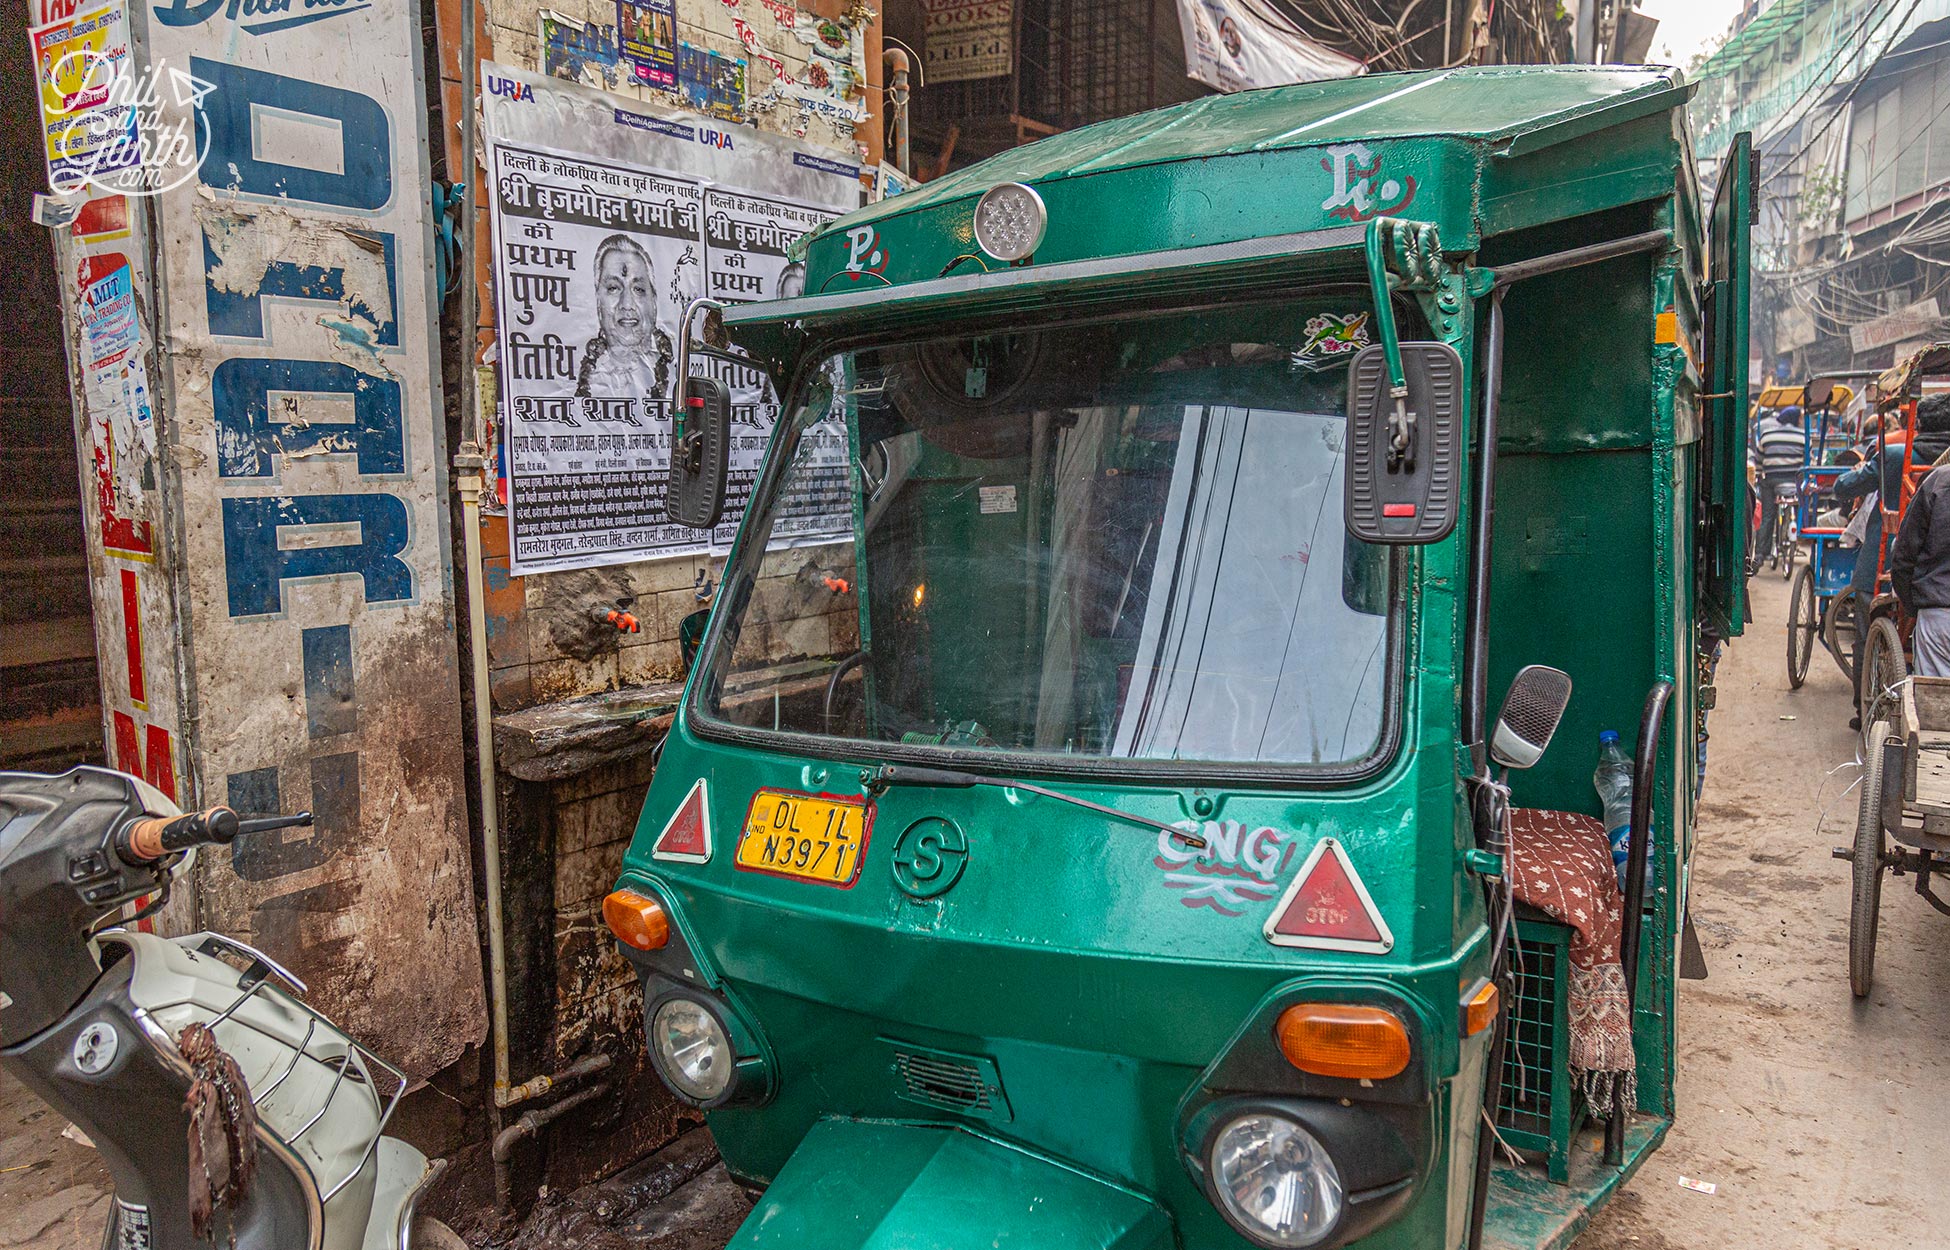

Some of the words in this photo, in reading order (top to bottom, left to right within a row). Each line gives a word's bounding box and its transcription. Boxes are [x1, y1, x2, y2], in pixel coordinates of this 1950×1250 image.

[488, 75, 535, 103] URJA
[621, 113, 694, 139] #DelhiAgainstPollution
[700, 128, 733, 150] URJA
[503, 152, 536, 171] दिल्ली
[540, 158, 550, 172] के
[553, 163, 598, 182] लोकप्रिय
[601, 170, 620, 186] नेता
[623, 177, 629, 188] व
[633, 178, 647, 194] पूर्व
[649, 178, 675, 195] निगम
[677, 183, 700, 200] पार्षद
[500, 174, 530, 208] श्री
[535, 185, 627, 226] बृजमोहन
[631, 198, 674, 232] शर्मा
[679, 204, 700, 233] जी
[710, 193, 735, 210] दिल्ली
[737, 199, 745, 211] के
[747, 202, 780, 218] लोकप्रिय
[782, 207, 797, 220] नेता
[807, 211, 818, 227] पूर्व
[524, 221, 553, 241] की
[706, 212, 731, 243] श्री
[507, 242, 576, 270] प्रथम
[724, 253, 746, 269] की
[712, 271, 763, 294] प्रथम
[510, 272, 570, 325] पुण्य
[510, 331, 577, 380] तिथि
[514, 397, 580, 427] शत्
[581, 397, 642, 427] शत्
[519, 538, 549, 554] रामनरेश
[609, 529, 624, 547] सिंह,
[644, 530, 660, 542] शर्मा,
[662, 527, 681, 541] अमित
[751, 824, 765, 834] IND
[773, 801, 801, 834] DL
[824, 807, 850, 841] 1L
[762, 835, 847, 878] N3971
[1158, 819, 1290, 880] CNG
[1305, 906, 1350, 926] STOP
